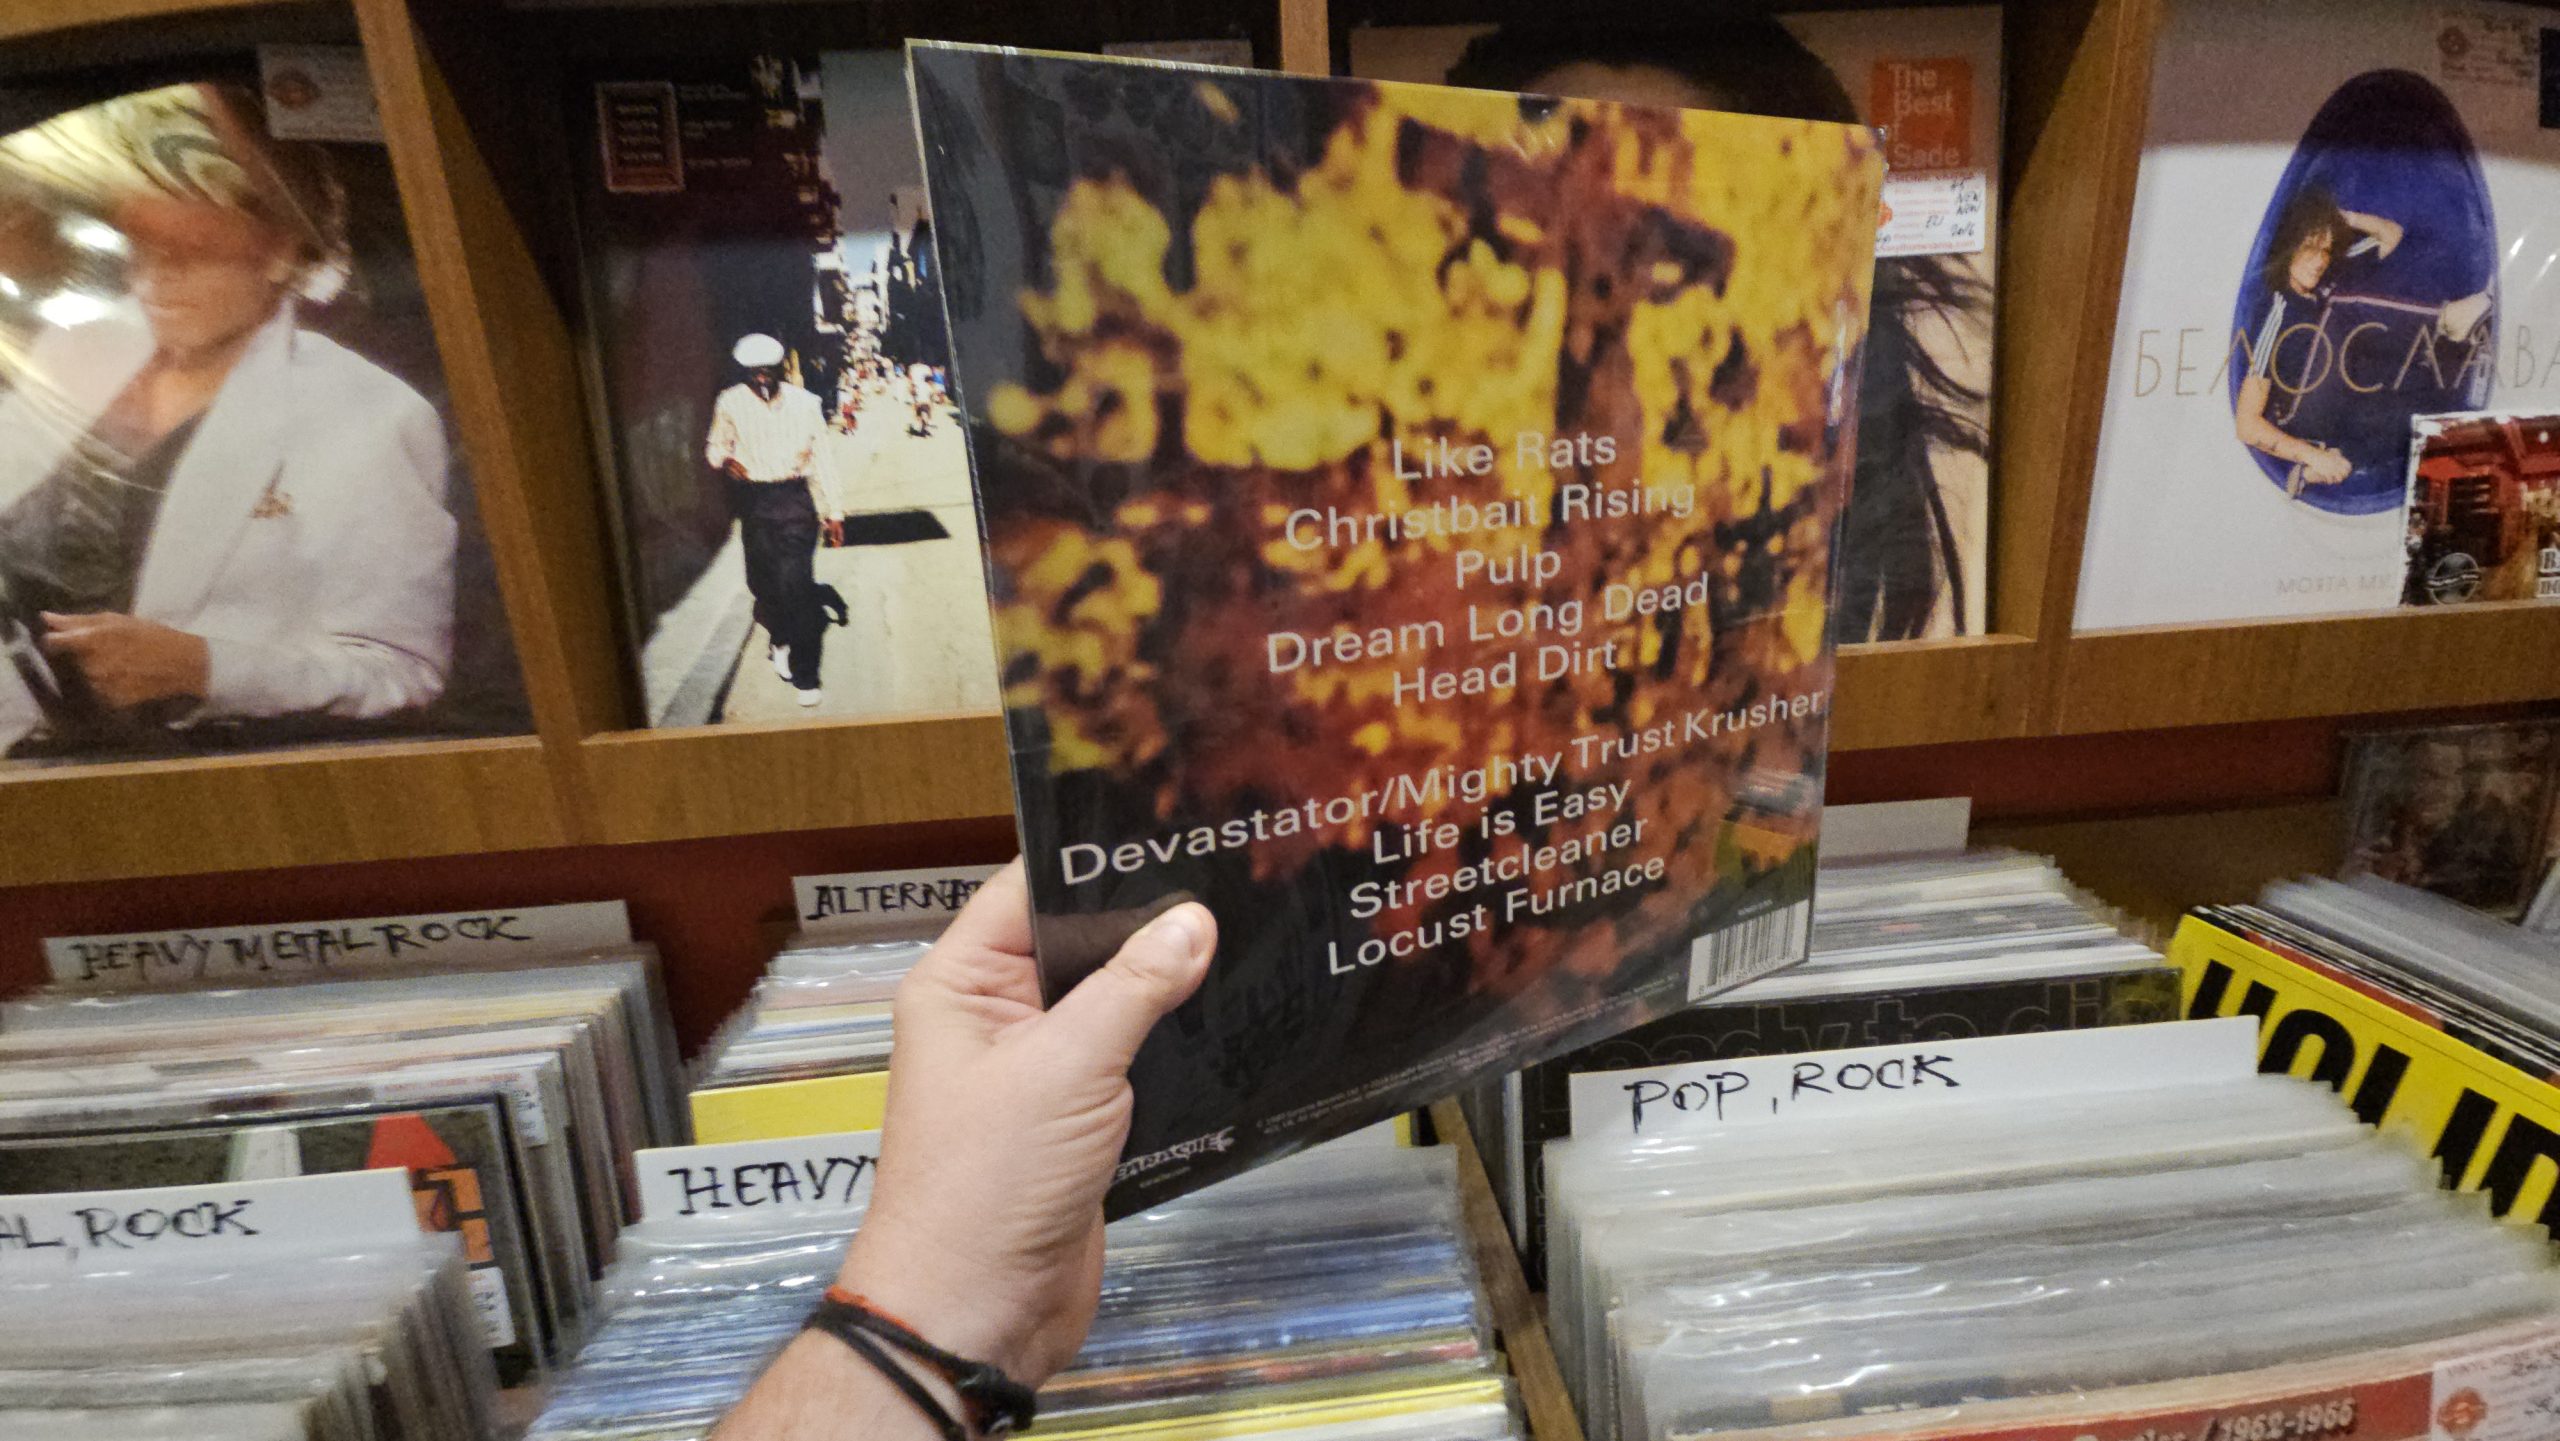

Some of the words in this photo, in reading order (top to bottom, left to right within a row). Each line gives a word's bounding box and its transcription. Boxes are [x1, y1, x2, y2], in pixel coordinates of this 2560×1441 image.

[1393, 436, 1494, 482] Like
[1515, 430, 1617, 471] Rats
[1285, 488, 1541, 552] Christbait
[1561, 478, 1696, 523] Rising
[1455, 543, 1562, 590] Pulp
[1266, 618, 1445, 674] Dream
[1468, 599, 1584, 643] Long
[1603, 572, 1709, 622] Dead
[1392, 652, 1518, 706] Head
[1537, 638, 1618, 682] Dirt
[1059, 751, 1563, 886] Devastator/Mighty
[1570, 721, 1677, 769] Trust
[1684, 689, 1824, 743] Krusher
[1372, 818, 1460, 865] Life
[1480, 806, 1516, 839] is
[1534, 778, 1632, 827] Easy
[1349, 817, 1649, 919] Streetcleaner
[68, 932, 211, 981] HEAVY
[223, 926, 375, 972] METAL
[373, 915, 532, 958] ROCK
[1327, 903, 1488, 976] Locust
[1505, 854, 1666, 923] Furnace
[1791, 1053, 1960, 1100] ROCK
[667, 1154, 871, 1216] HEAVY
[74, 1199, 259, 1250] ROCK
